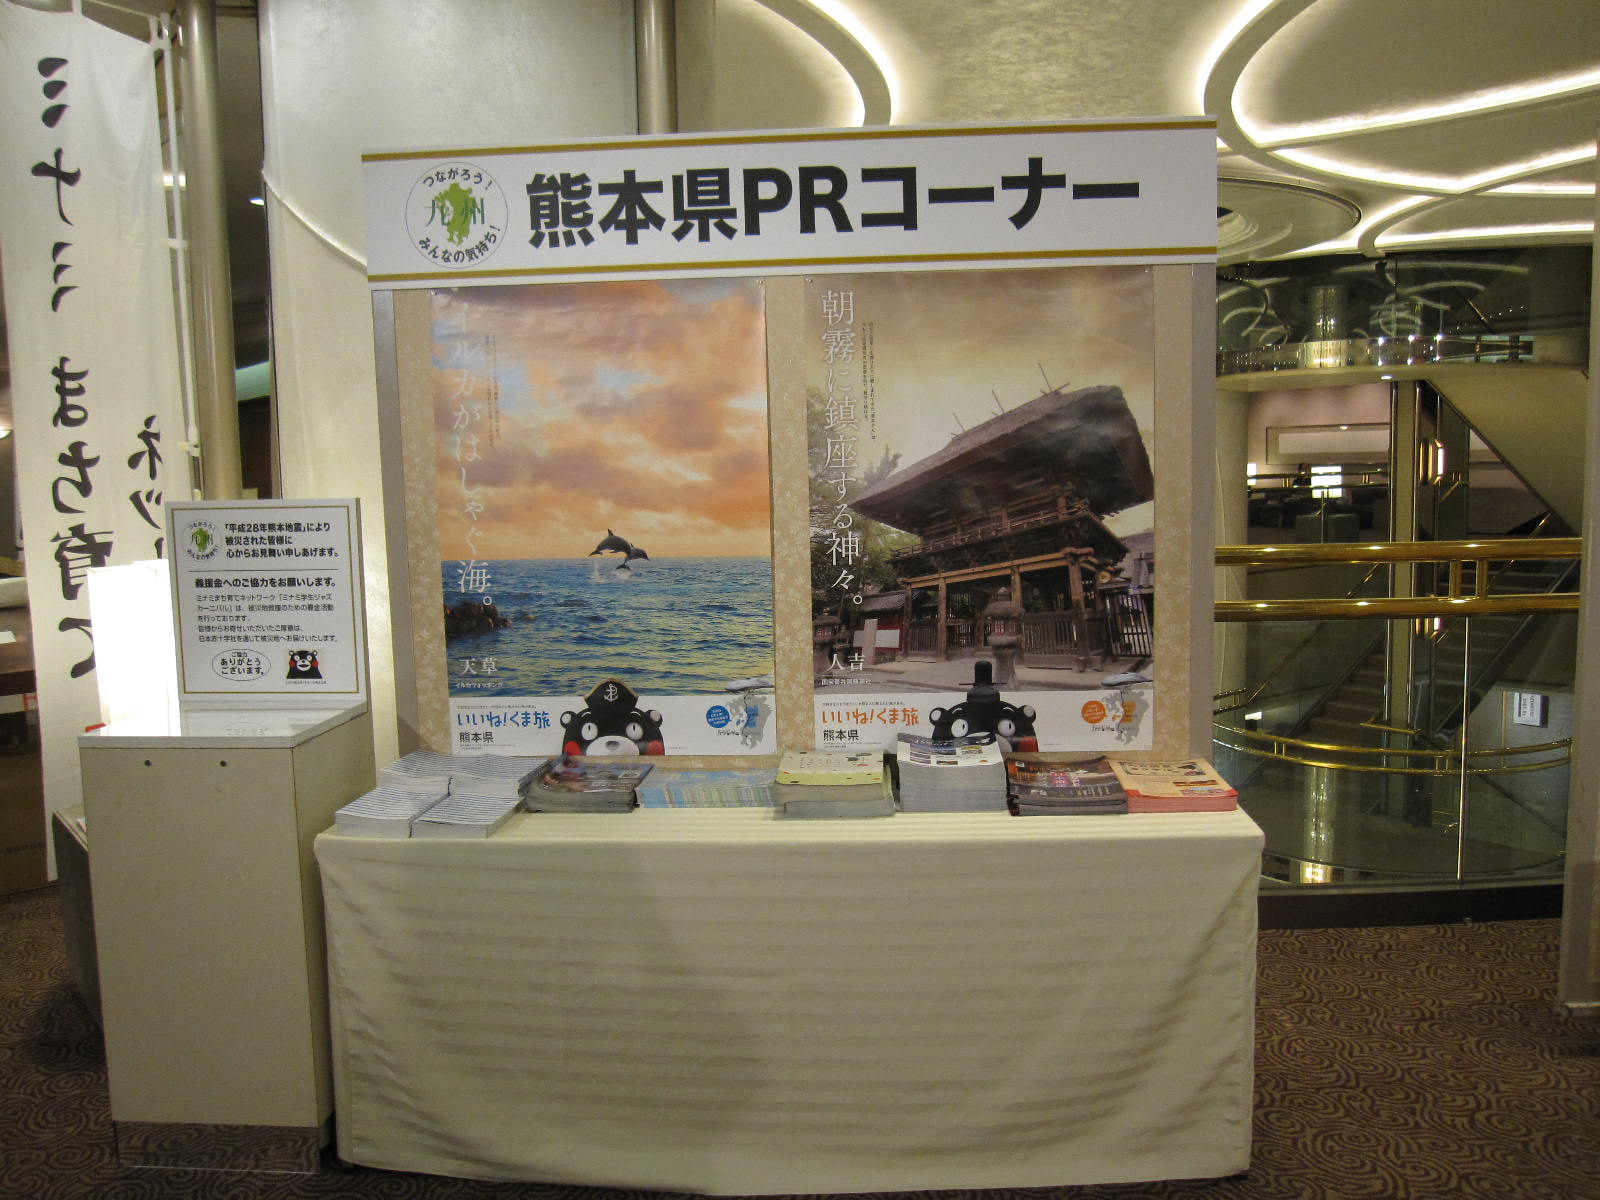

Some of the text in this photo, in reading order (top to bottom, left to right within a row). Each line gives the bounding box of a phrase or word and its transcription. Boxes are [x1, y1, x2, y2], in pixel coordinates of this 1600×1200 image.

[422, 168, 493, 190] つながろう！
[526, 156, 1140, 250] 熊本県PRコーナー
[418, 224, 501, 263] みんなの気持ち！
[450, 302, 493, 606] イルカがはしゃぐ海。
[820, 290, 863, 605] 朝霧に鎮座する神々。
[225, 522, 331, 534] 「平成28年熊本地震」により
[225, 535, 293, 546] 被災された皆様に
[195, 577, 336, 588] 義援金へのご協力をお願いします。
[220, 657, 261, 666] ありがとう
[460, 658, 498, 675] 天草
[827, 652, 866, 671] 人吉
[221, 666, 265, 676] ございます。
[457, 711, 551, 729] いいね！くま旅
[822, 708, 919, 726] いいね！くま旅
[460, 731, 494, 743] 熊本県
[823, 729, 860, 742] 熊本県
